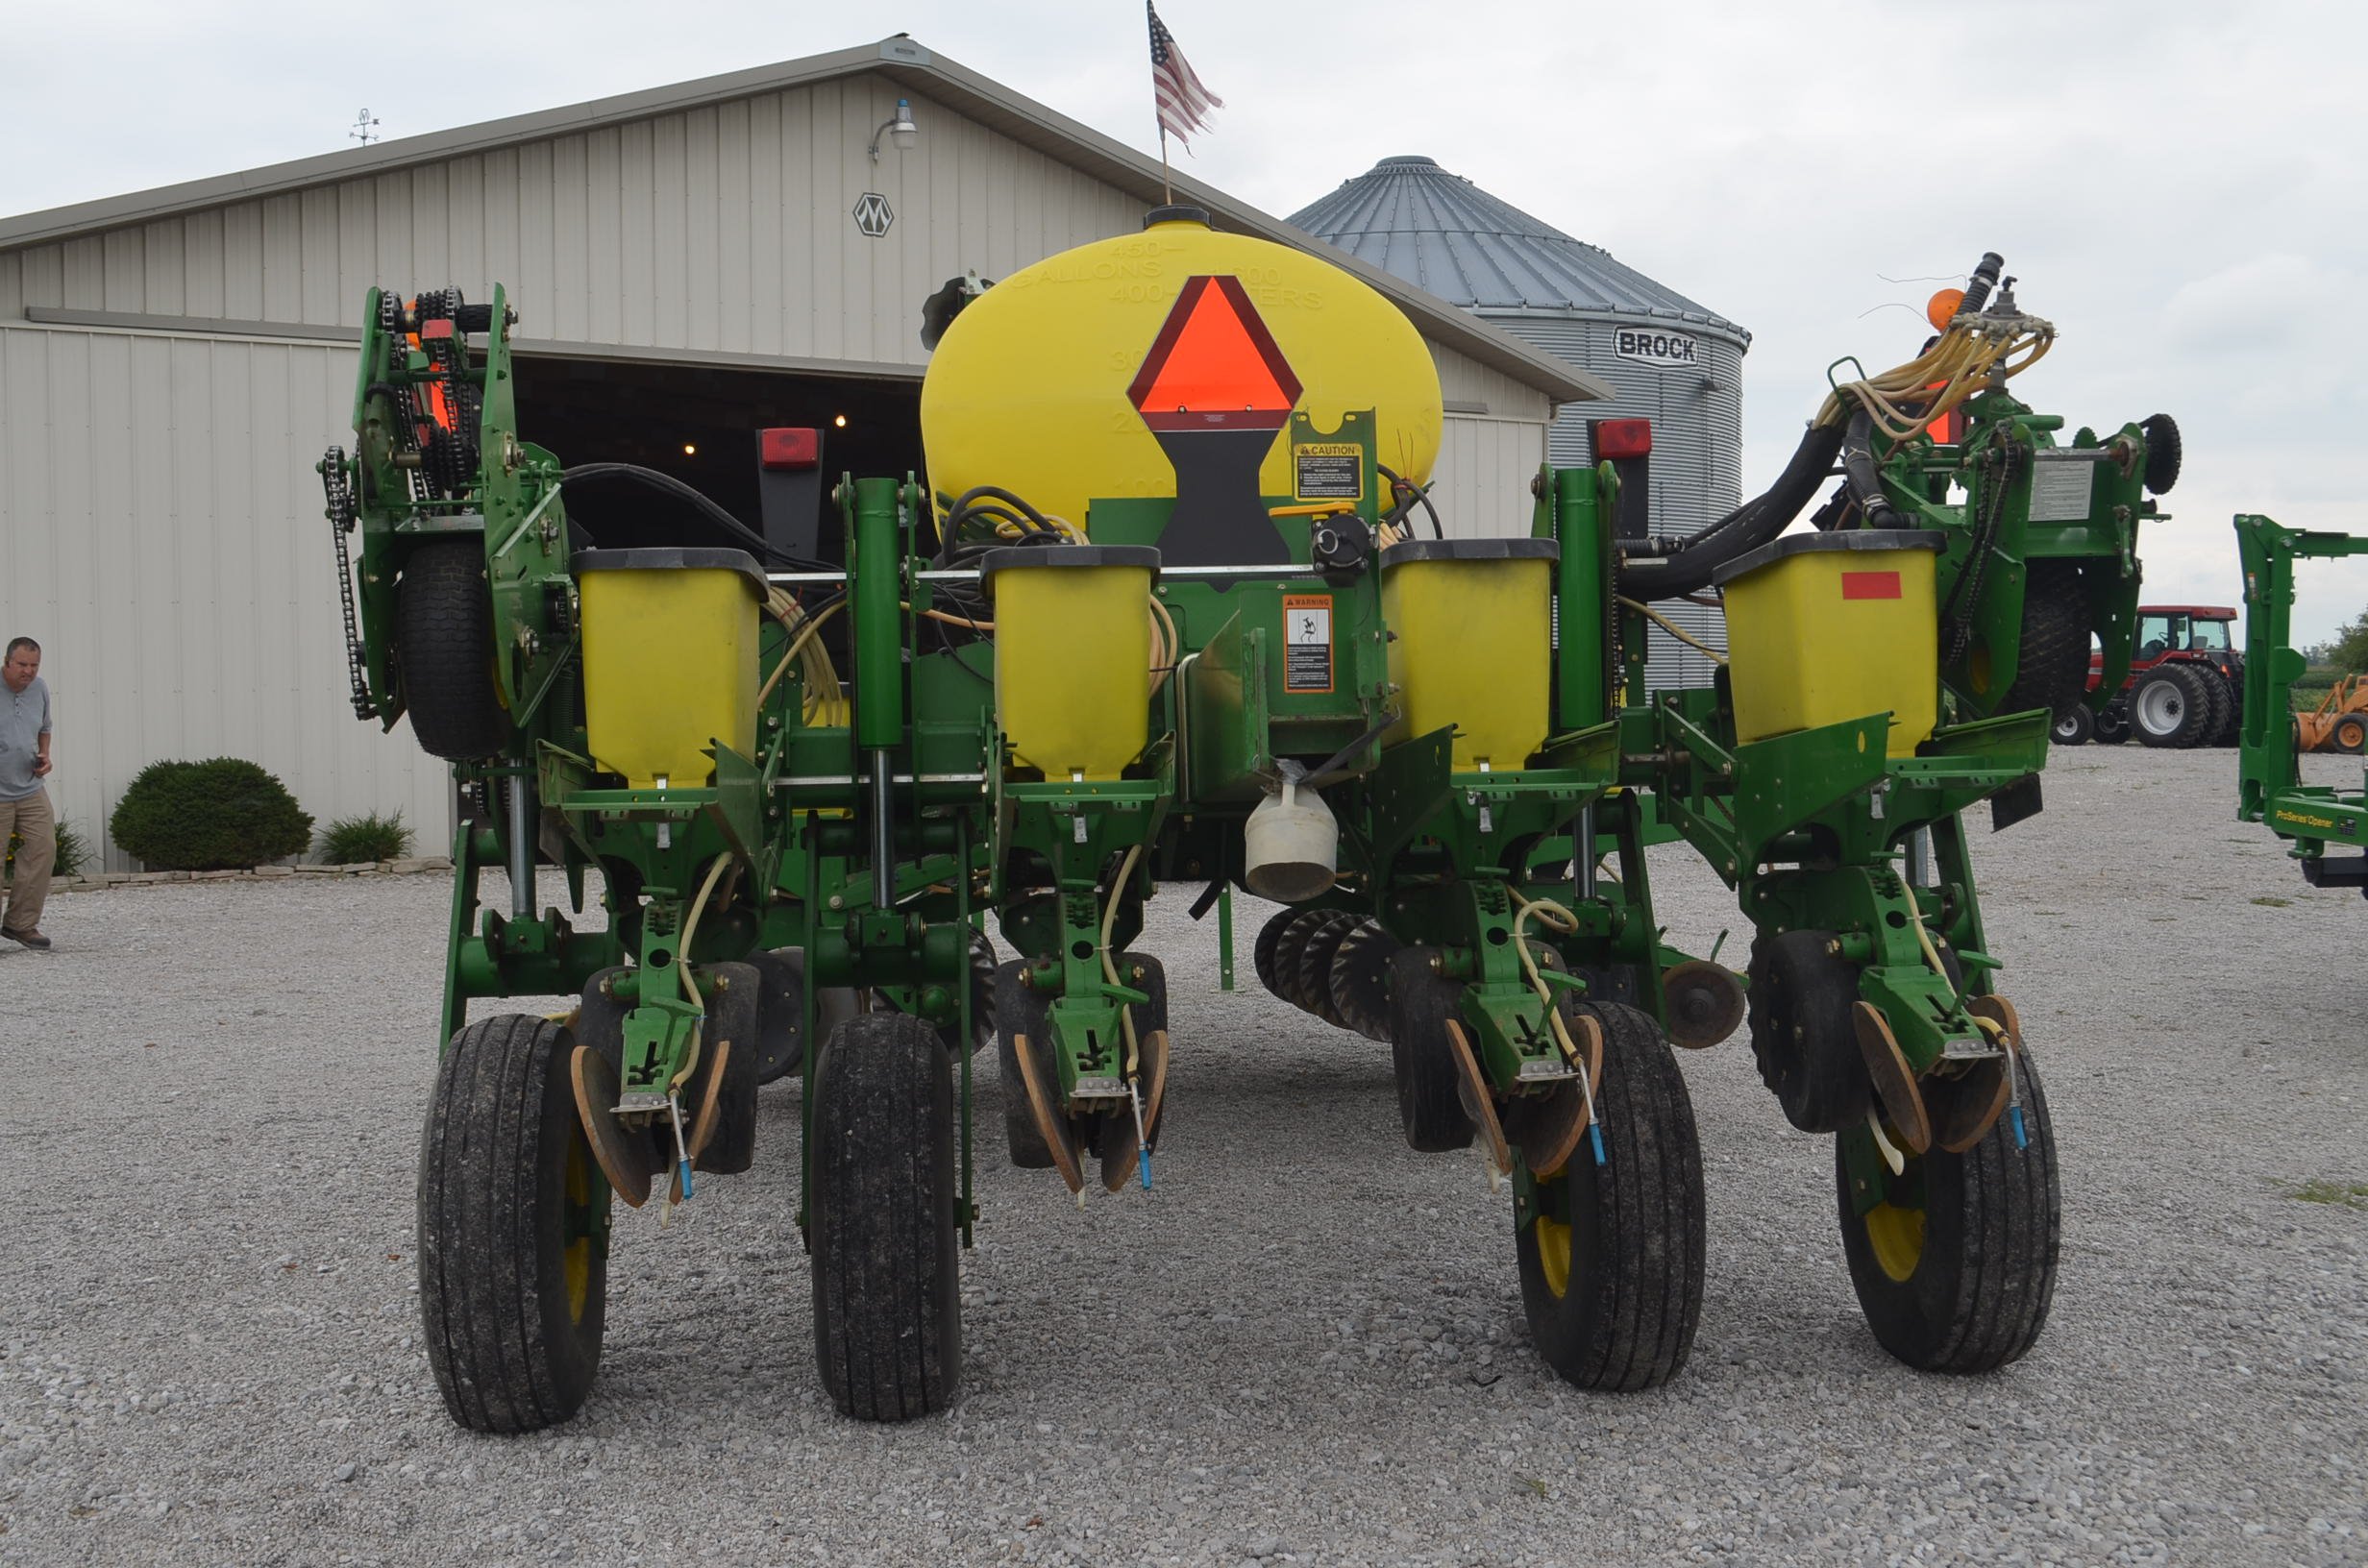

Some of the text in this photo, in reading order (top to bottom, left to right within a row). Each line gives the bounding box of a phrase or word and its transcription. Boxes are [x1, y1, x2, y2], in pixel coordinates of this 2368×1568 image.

[1109, 240, 1162, 258] 450
[1010, 259, 1162, 288] GALLONS
[1108, 283, 1164, 303] 400
[1250, 285, 1323, 310] TERS
[1619, 332, 1696, 362] BROCK
[1110, 347, 1145, 372] 30
[1311, 446, 1355, 455] CAUTION
[1295, 599, 1330, 607] WARNING
[2307, 814, 2333, 828] Opener
